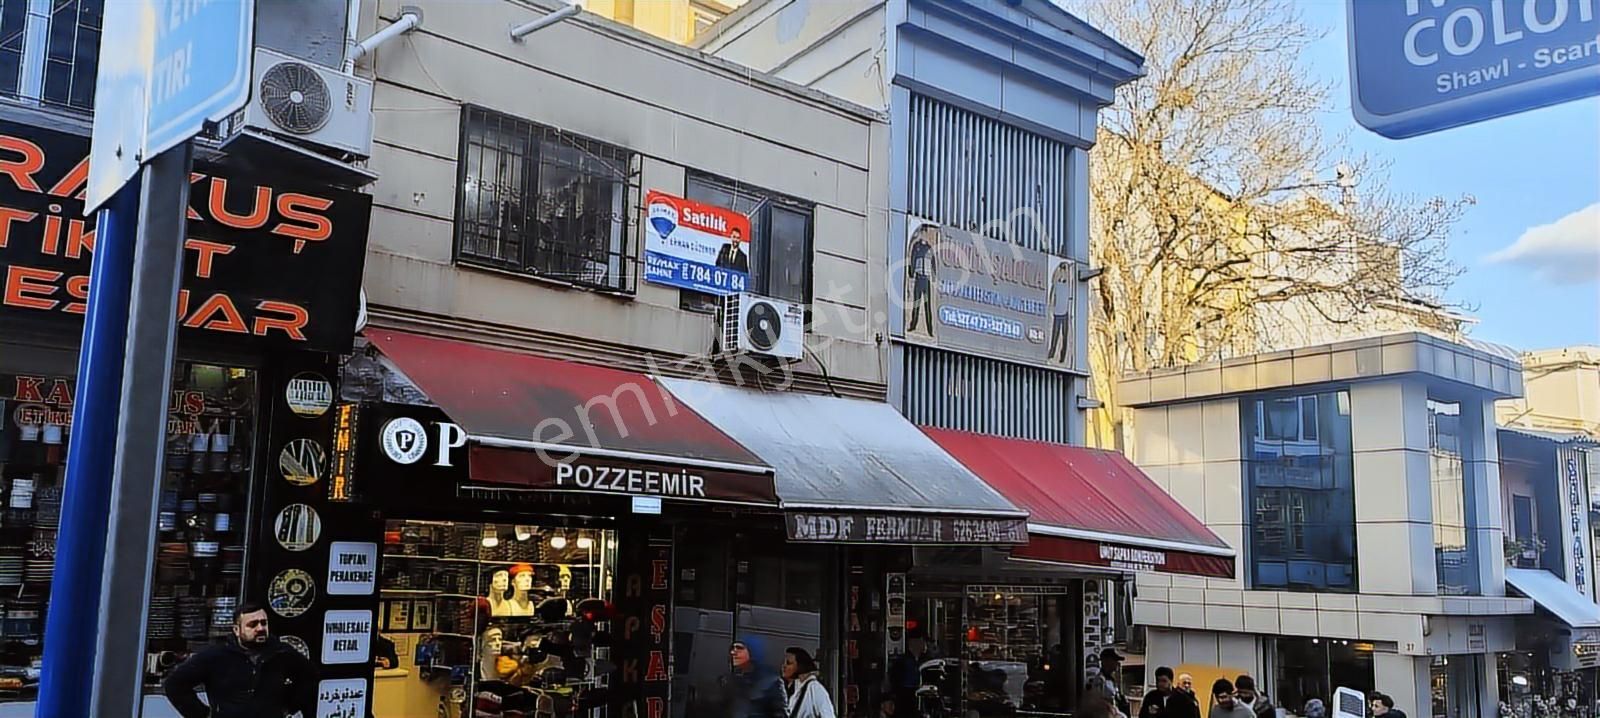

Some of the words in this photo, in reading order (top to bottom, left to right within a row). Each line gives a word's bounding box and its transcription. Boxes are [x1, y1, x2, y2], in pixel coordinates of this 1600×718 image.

[1436, 57, 1509, 93] Shawl
[682, 207, 728, 233] Satılık
[690, 264, 711, 284] 784
[714, 271, 728, 287] 07
[731, 274, 745, 291] 84
[556, 462, 706, 497] POZZEEMİR
[795, 514, 854, 539] MDF
[866, 517, 942, 542] FERMUAR
[325, 621, 370, 634] WHOLESALE
[333, 639, 359, 651] RETAIL
